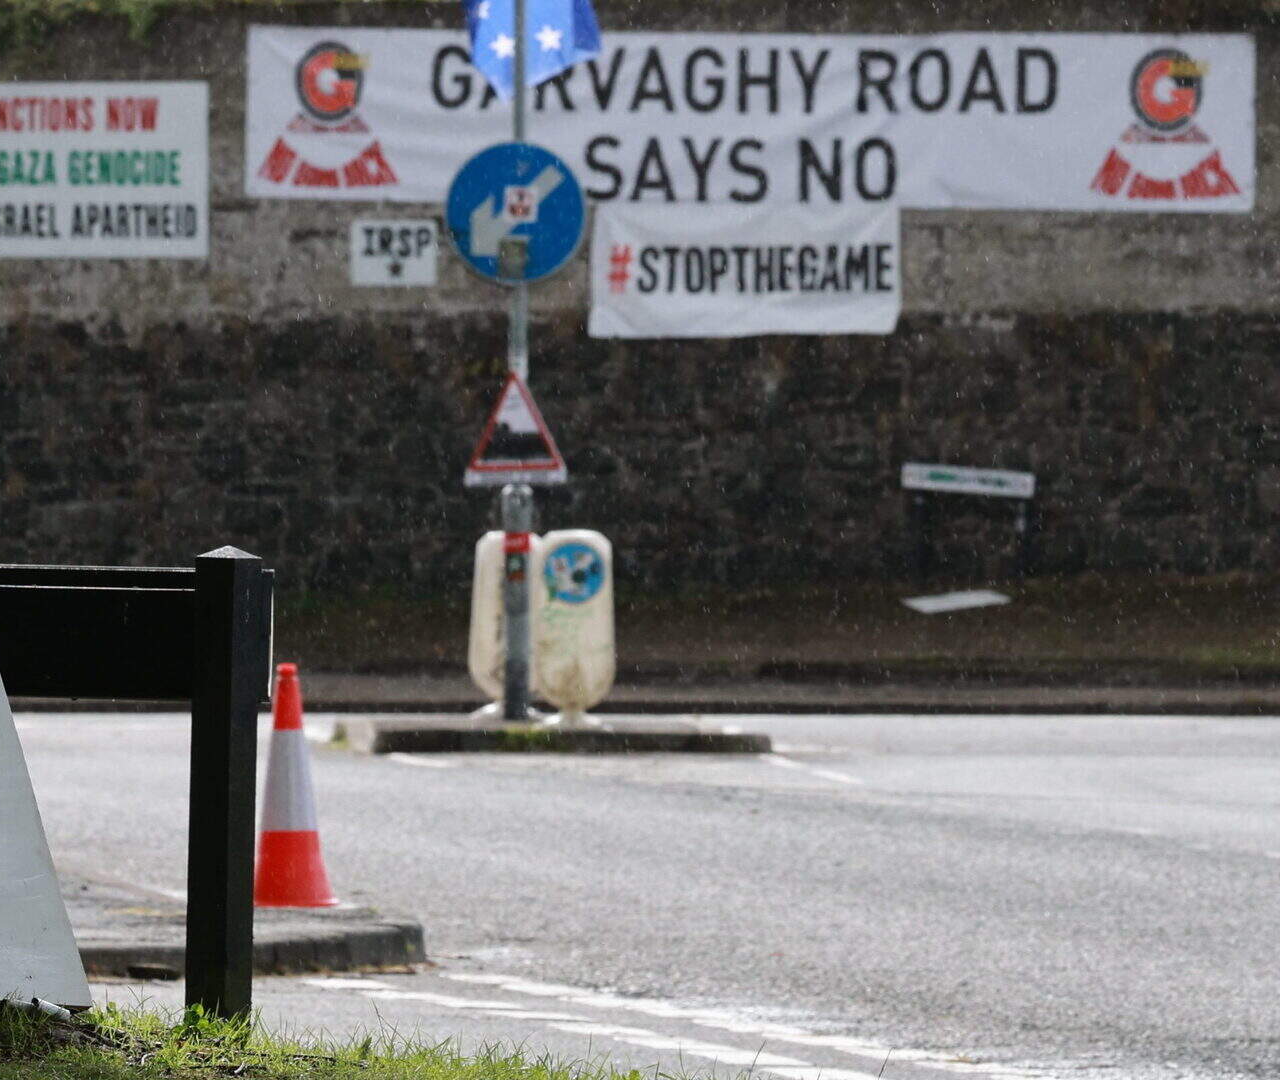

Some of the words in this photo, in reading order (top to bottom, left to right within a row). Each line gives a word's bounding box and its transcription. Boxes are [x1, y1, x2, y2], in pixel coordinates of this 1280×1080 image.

[432, 45, 831, 114] GRVAGHY
[854, 46, 1059, 115] ROAD
[107, 97, 158, 132] NOW
[67, 150, 181, 187] GENOCIDE
[585, 135, 769, 203] SAYS
[797, 136, 898, 203] NO
[71, 203, 198, 239] APARTHEID
[363, 226, 433, 257] IRSP
[608, 243, 894, 295] #STOPTHEGAME
